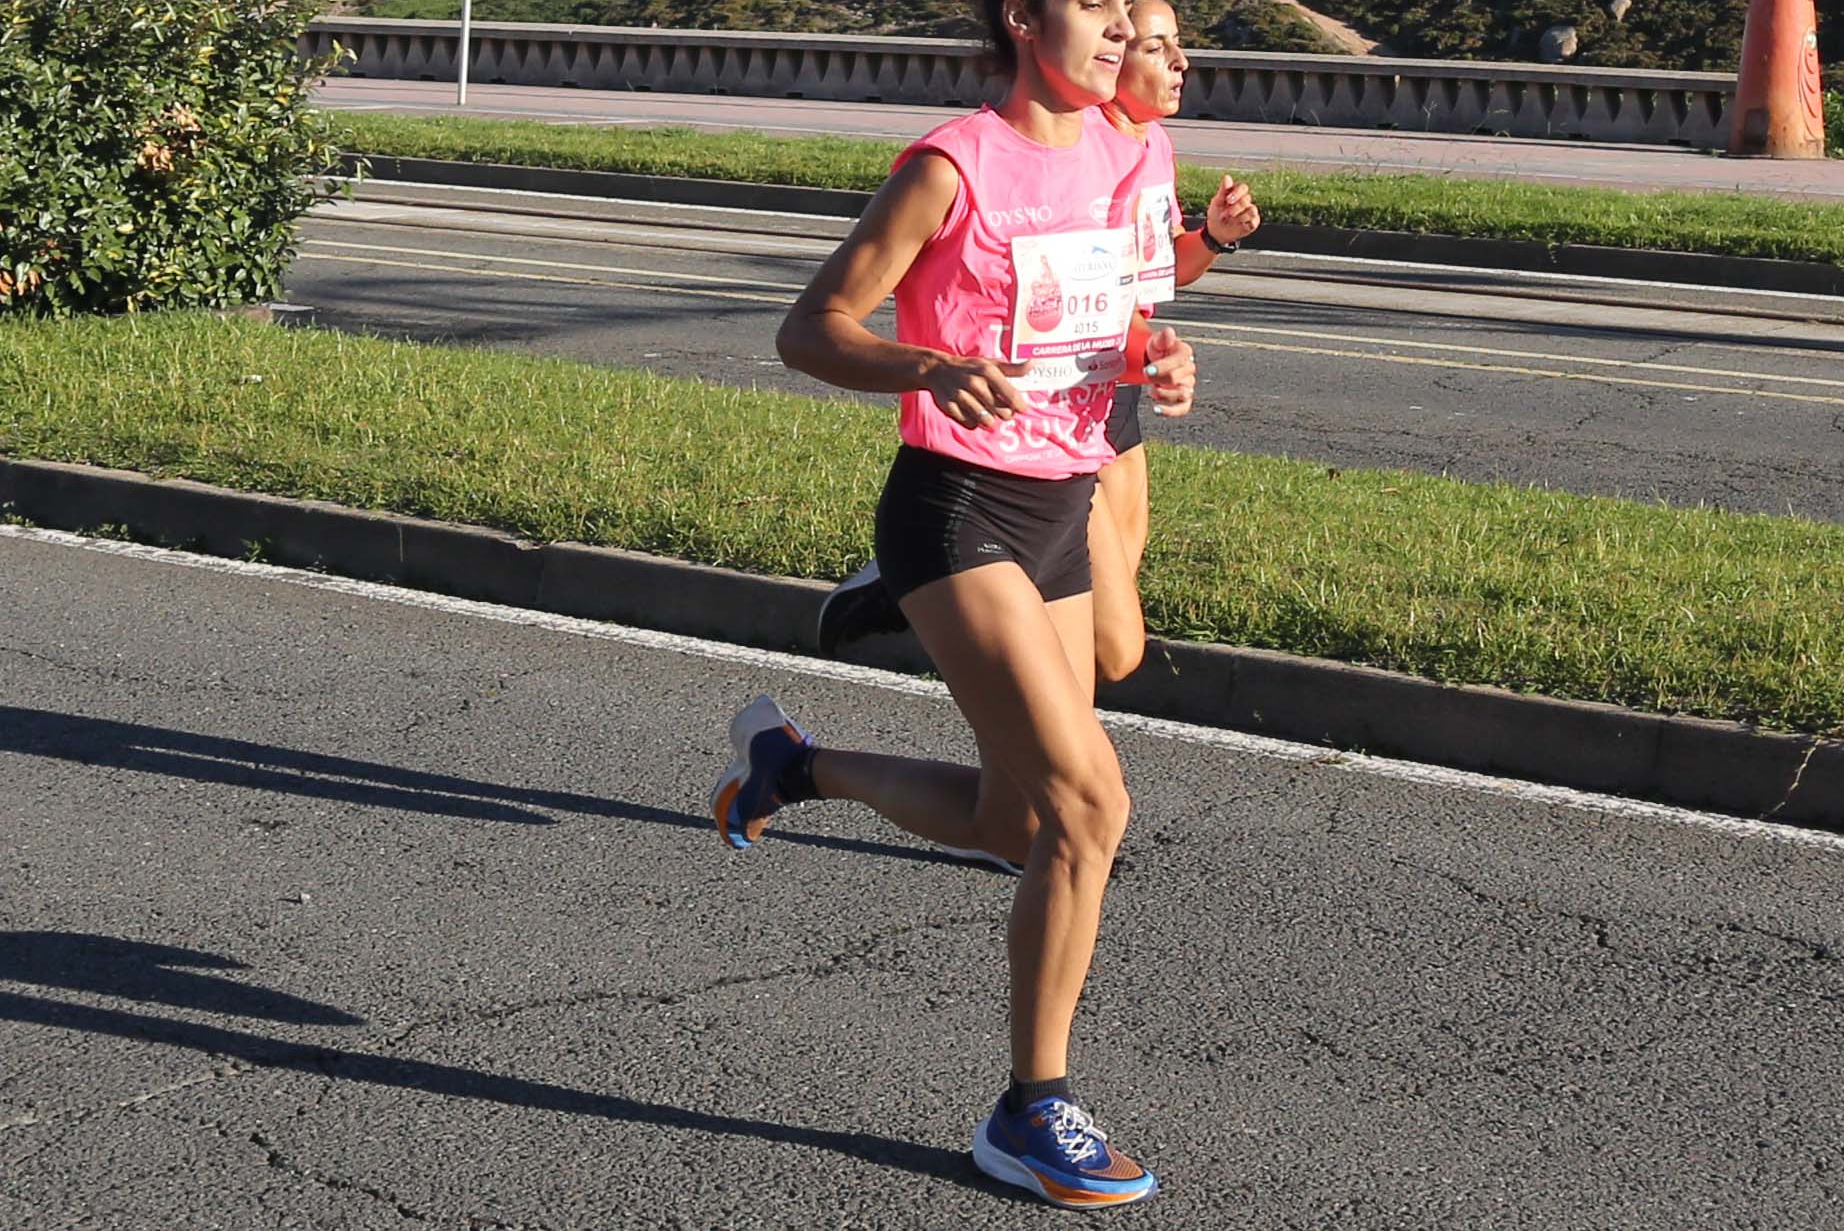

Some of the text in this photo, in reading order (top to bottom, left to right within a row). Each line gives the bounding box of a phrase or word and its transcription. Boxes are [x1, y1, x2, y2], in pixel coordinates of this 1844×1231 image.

[988, 205, 1052, 226] OYSHO
[1067, 292, 1109, 315] 016
[1032, 344, 1072, 355] CARRERA
